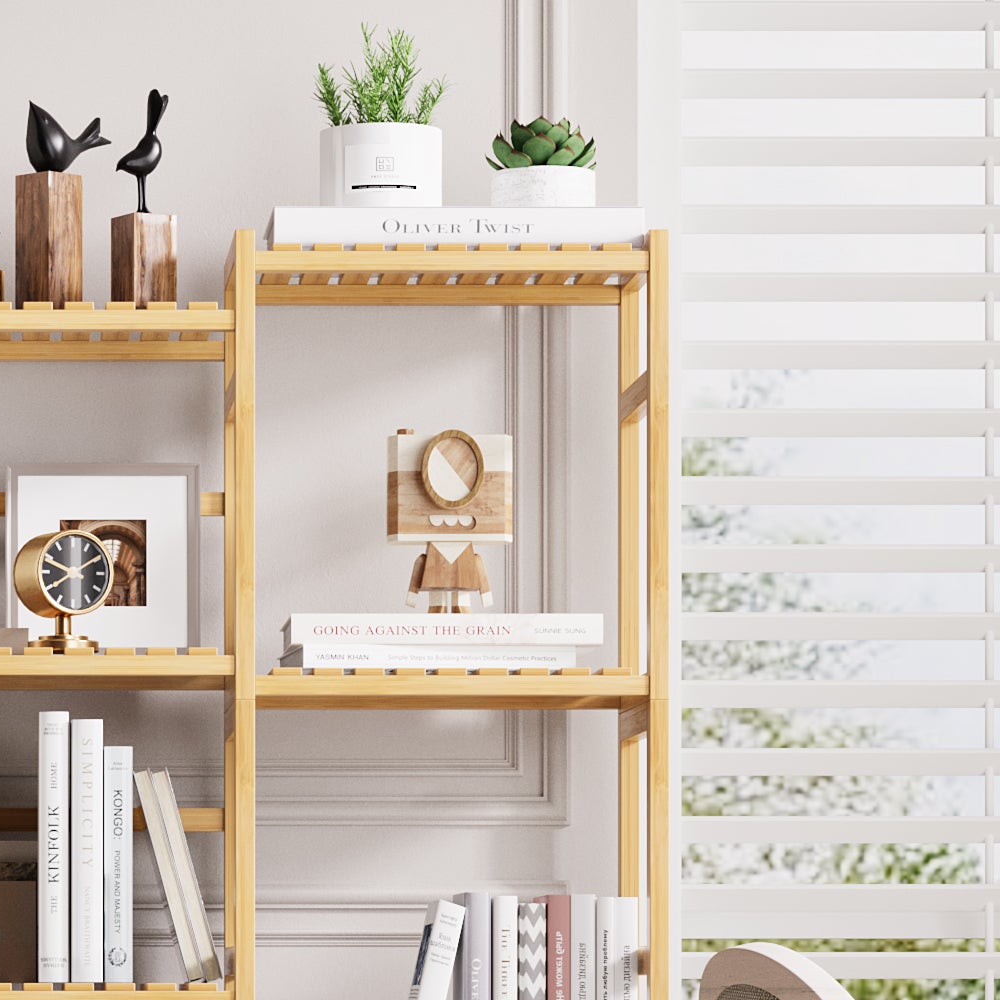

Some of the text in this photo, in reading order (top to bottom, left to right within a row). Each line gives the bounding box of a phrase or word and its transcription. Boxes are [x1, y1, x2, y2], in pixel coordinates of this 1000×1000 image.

[382, 219, 535, 234] OLIVER TWIST
[313, 625, 512, 636] GOING AGAINST THE GRAIN
[81, 737, 94, 868] SIMPLICITY
[47, 805, 60, 885] KINFOLK
